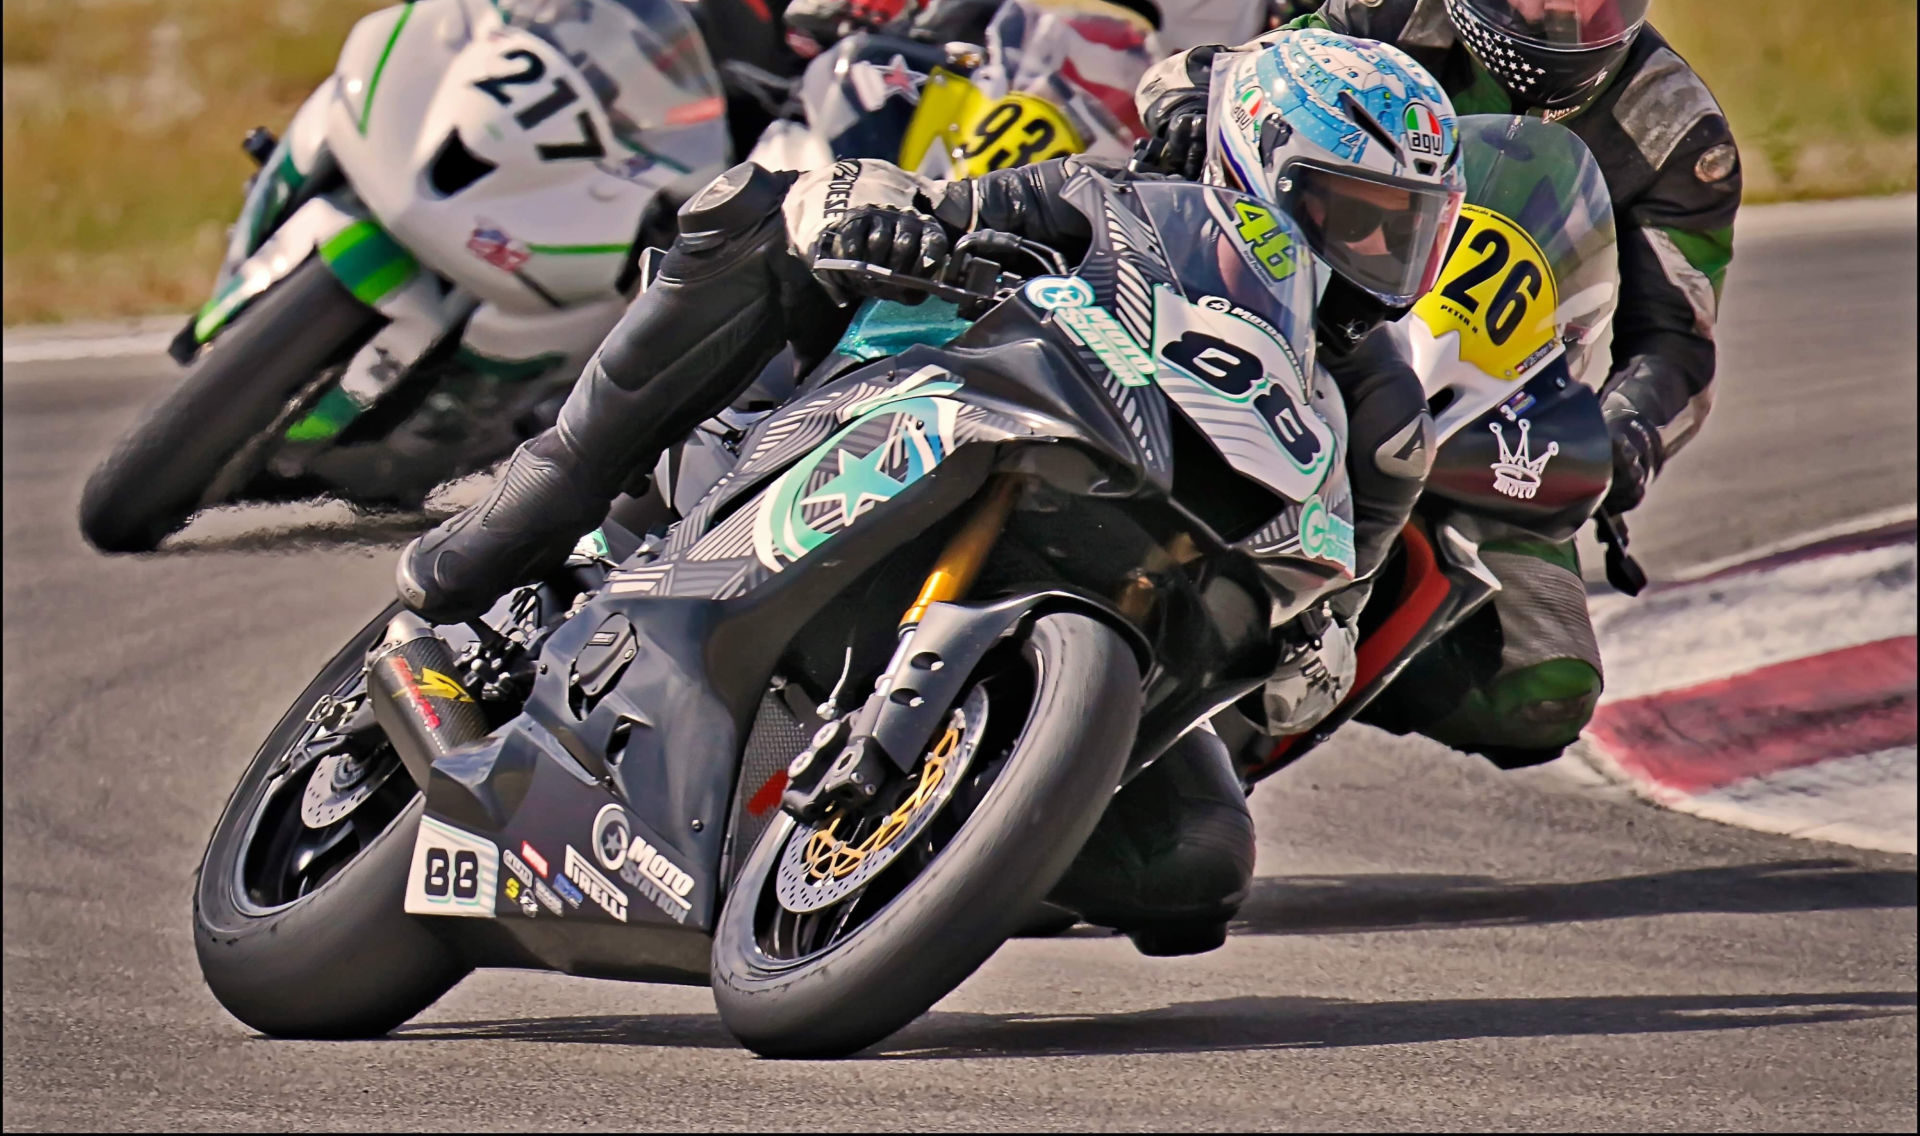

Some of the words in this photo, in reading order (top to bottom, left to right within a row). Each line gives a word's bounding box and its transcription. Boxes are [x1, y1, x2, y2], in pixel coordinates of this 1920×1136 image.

[473, 49, 606, 162] 217
[1233, 199, 1297, 282] 46
[1055, 307, 1150, 387] STATION
[1078, 306, 1156, 375] MOTO
[1440, 304, 1471, 326] PETER
[1160, 330, 1322, 466] 88
[424, 847, 479, 900] 88
[564, 843, 629, 924] PIRELLI
[620, 858, 690, 925] STATION
[626, 835, 695, 898] MOTO
